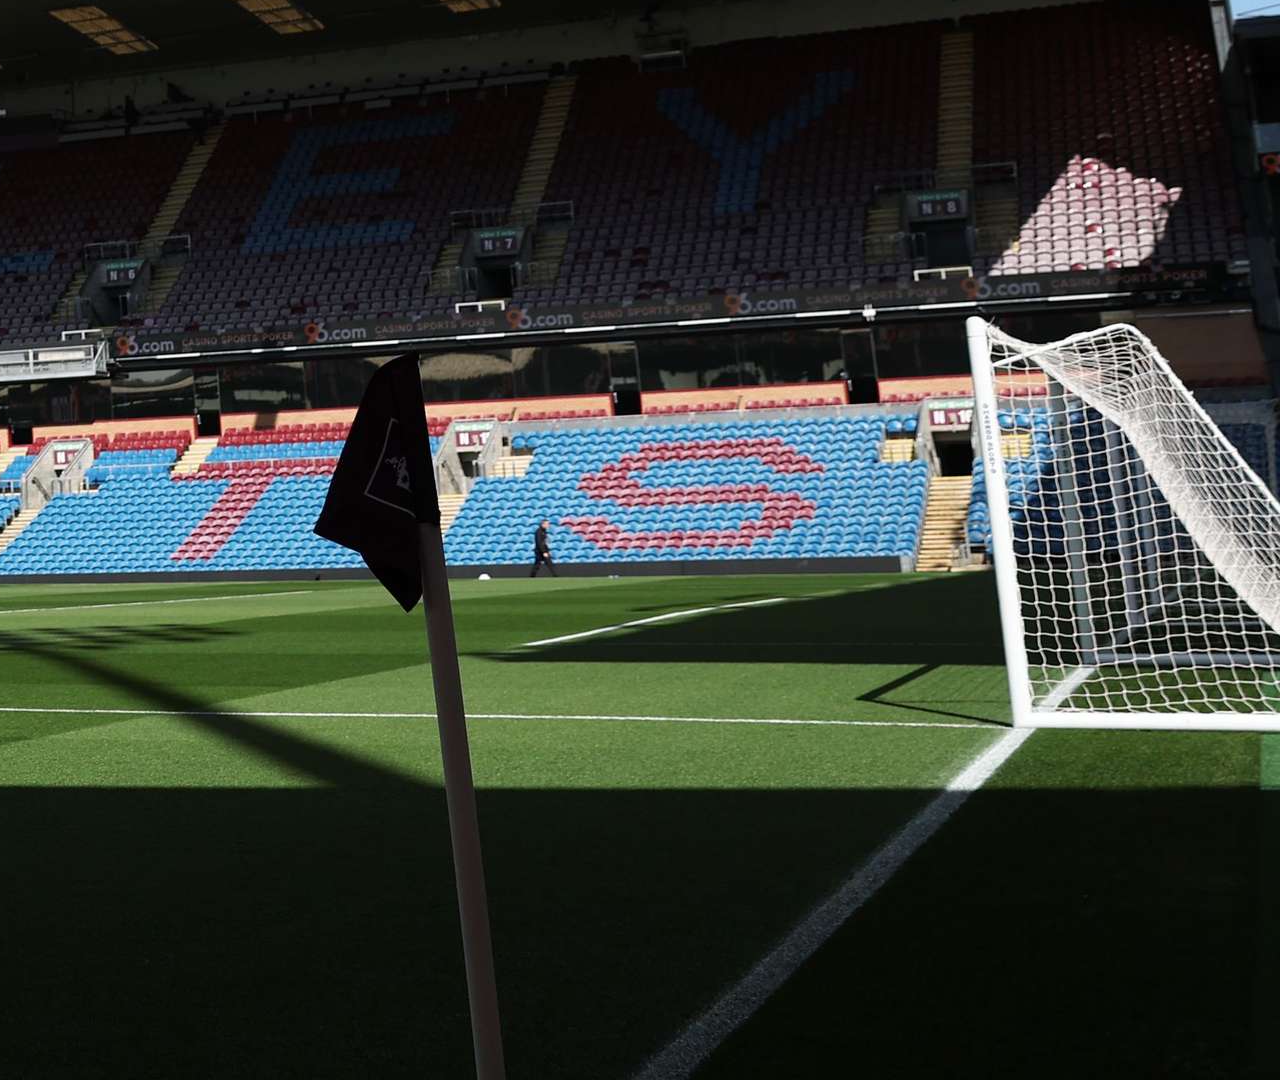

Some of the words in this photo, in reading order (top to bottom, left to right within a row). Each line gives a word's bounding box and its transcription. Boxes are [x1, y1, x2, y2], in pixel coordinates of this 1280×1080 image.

[960, 276, 1041, 299] 96.com
[1051, 277, 1101, 289] CASINO
[1165, 269, 1208, 281] POKER
[725, 292, 797, 315] 96.com
[506, 306, 574, 330] 96.com
[582, 310, 624, 321] CASINO
[628, 306, 669, 317] SPORTS
[675, 303, 712, 314] POKER
[304, 321, 367, 345] 96.com
[115, 335, 175, 356] 96.com
